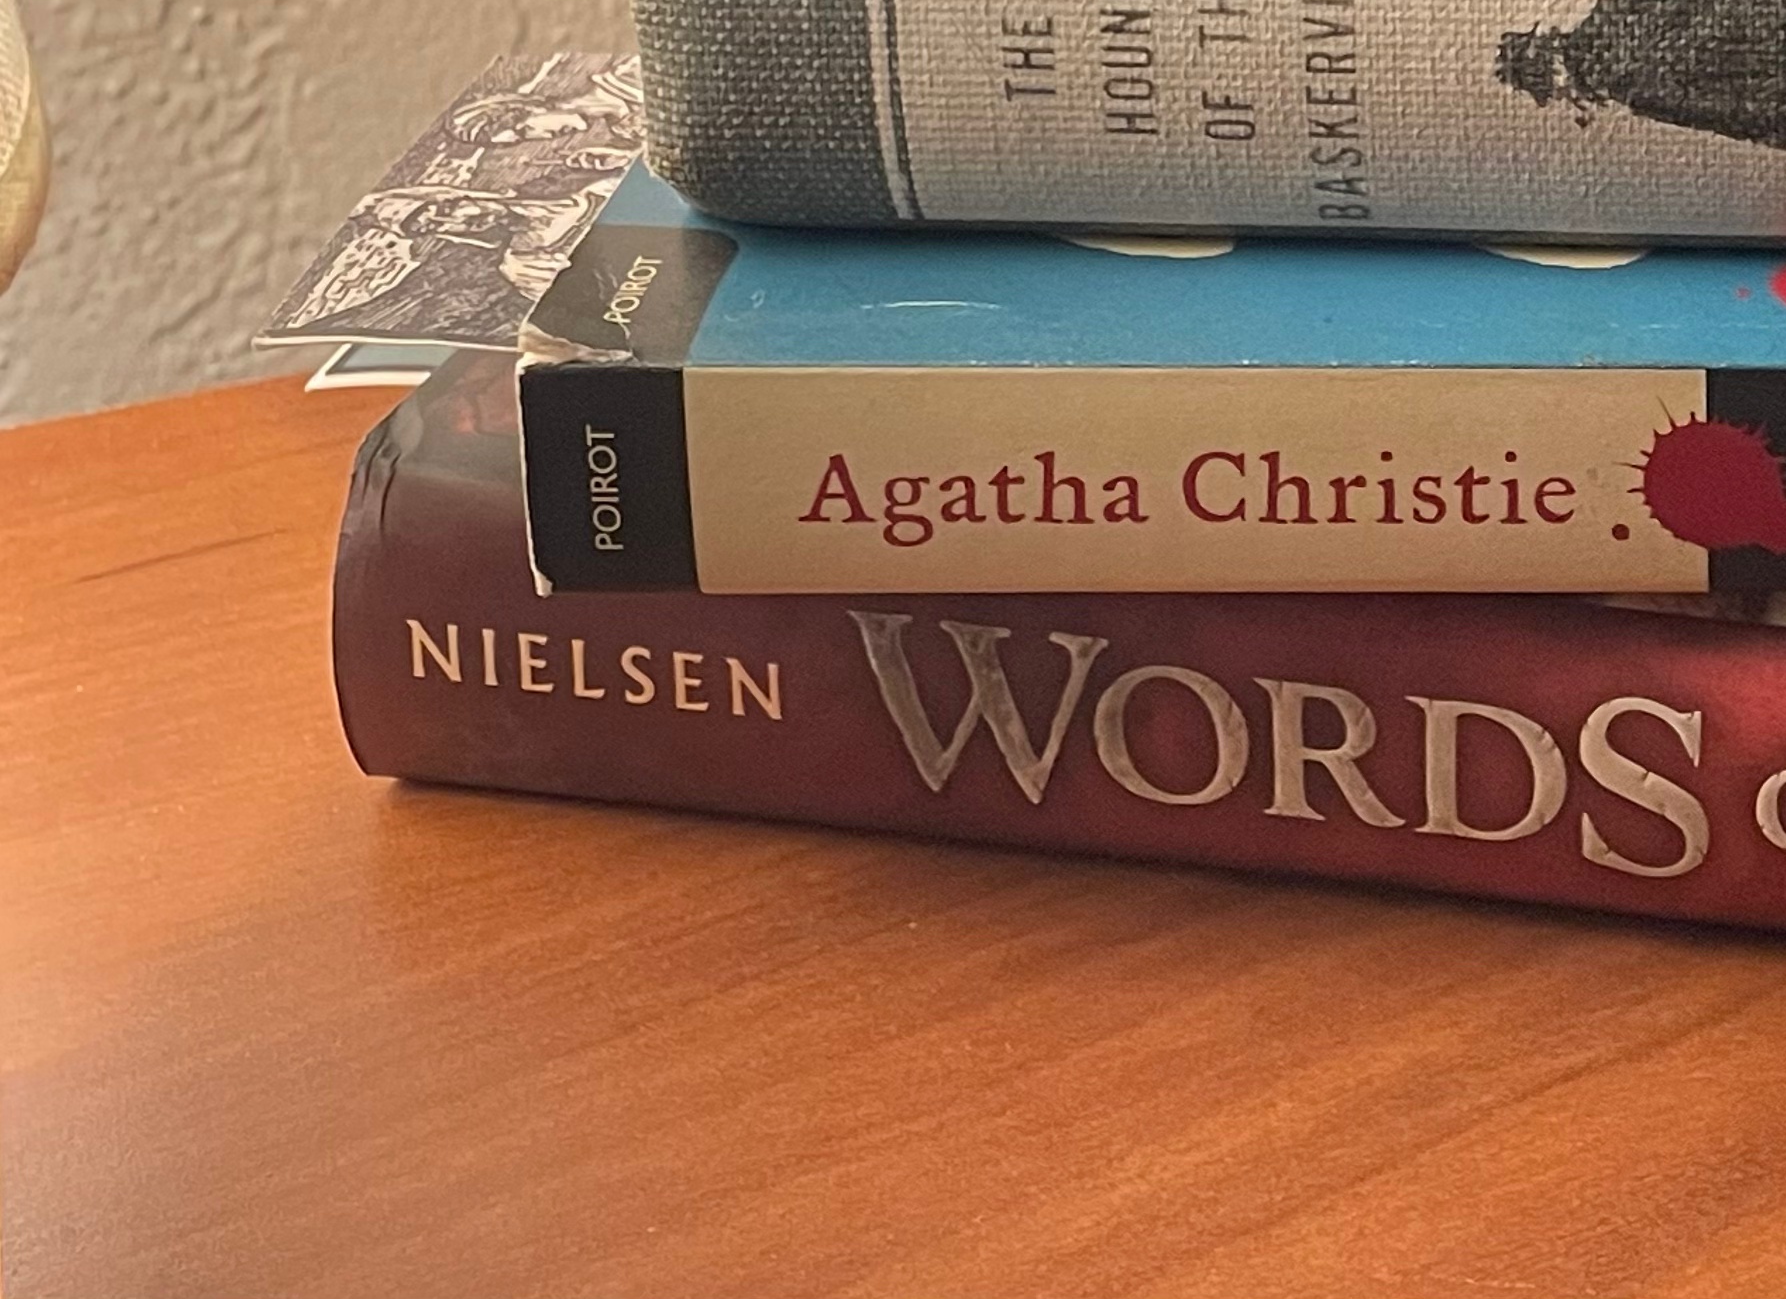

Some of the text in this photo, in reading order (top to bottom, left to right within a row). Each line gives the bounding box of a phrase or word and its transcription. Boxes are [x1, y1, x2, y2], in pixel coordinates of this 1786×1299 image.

[1001, 15, 1057, 102] THE
[1204, 90, 1256, 142] OF
[603, 255, 664, 325] POIROT
[585, 423, 624, 550] POIROT
[797, 450, 1577, 548] Agatha Christie
[405, 618, 783, 722] NIELSEN
[847, 608, 1706, 878] WORDS
